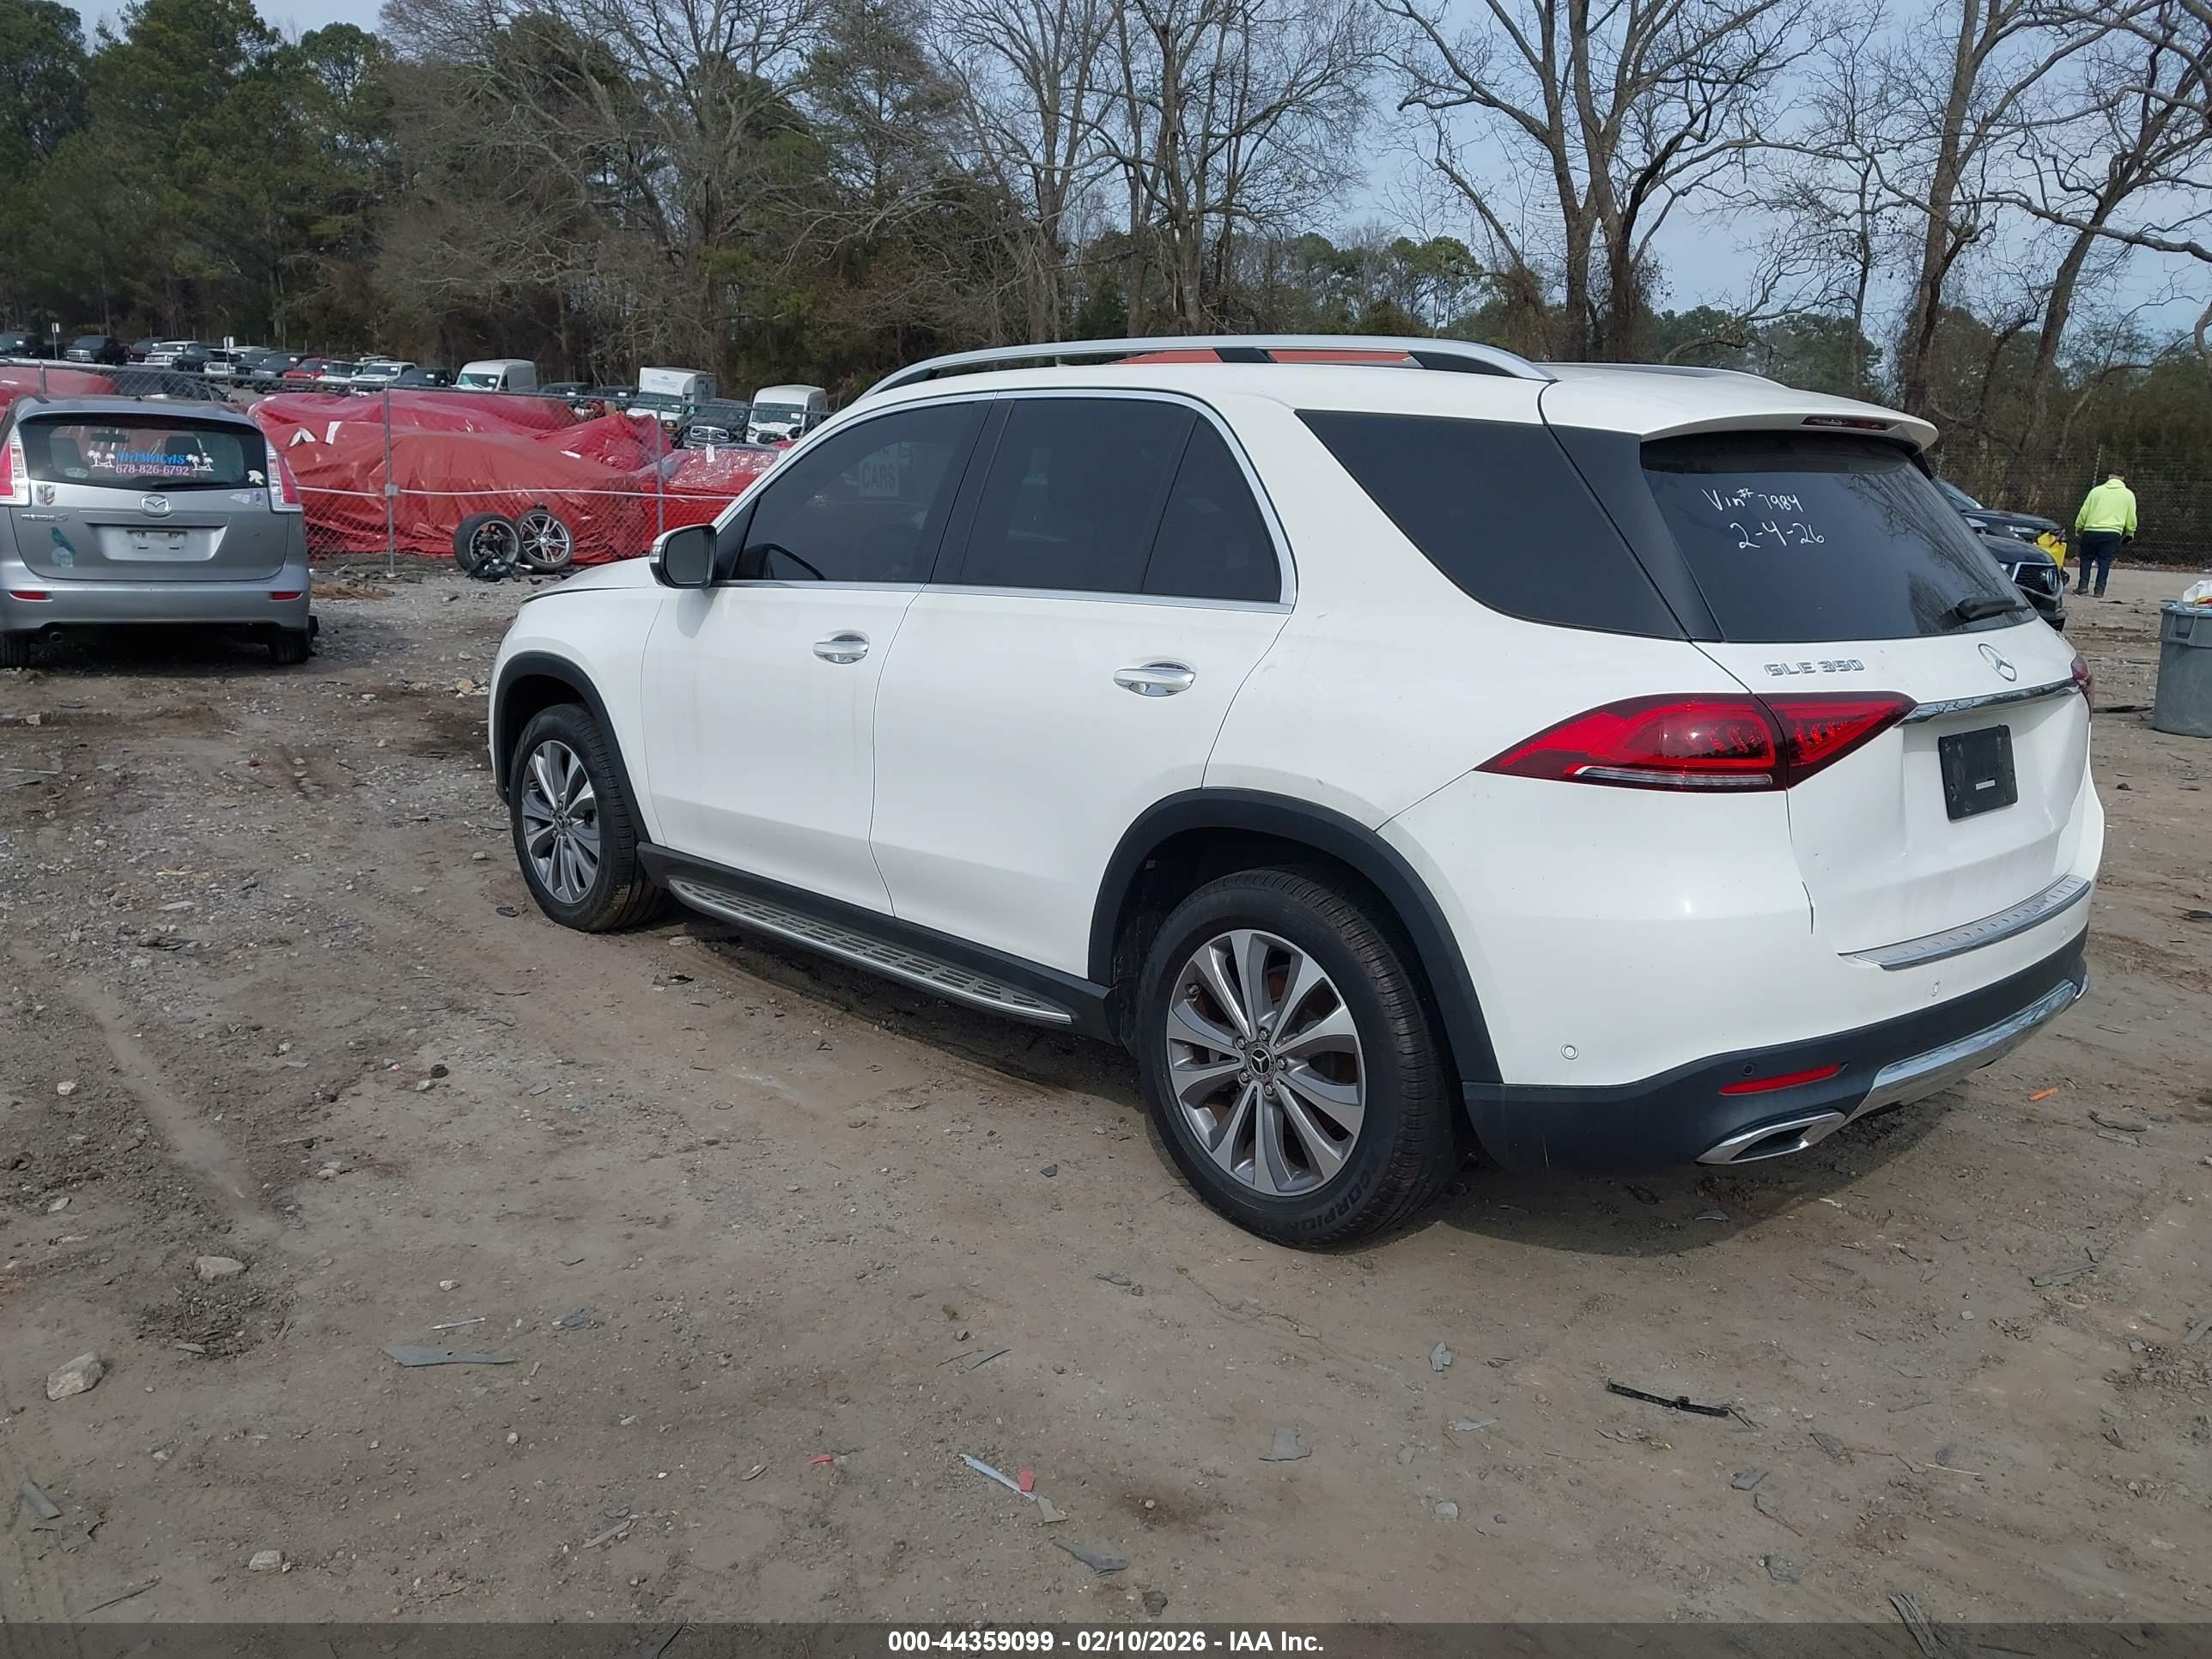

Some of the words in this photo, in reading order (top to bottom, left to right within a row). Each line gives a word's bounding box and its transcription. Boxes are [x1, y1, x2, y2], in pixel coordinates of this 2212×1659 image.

[115, 464, 190, 476] 678-826-6792
[1758, 494, 1804, 514] 7984
[1729, 520, 1825, 549] 2-4-26
[1763, 661, 1817, 677] GLE
[1817, 658, 1865, 673] 350
